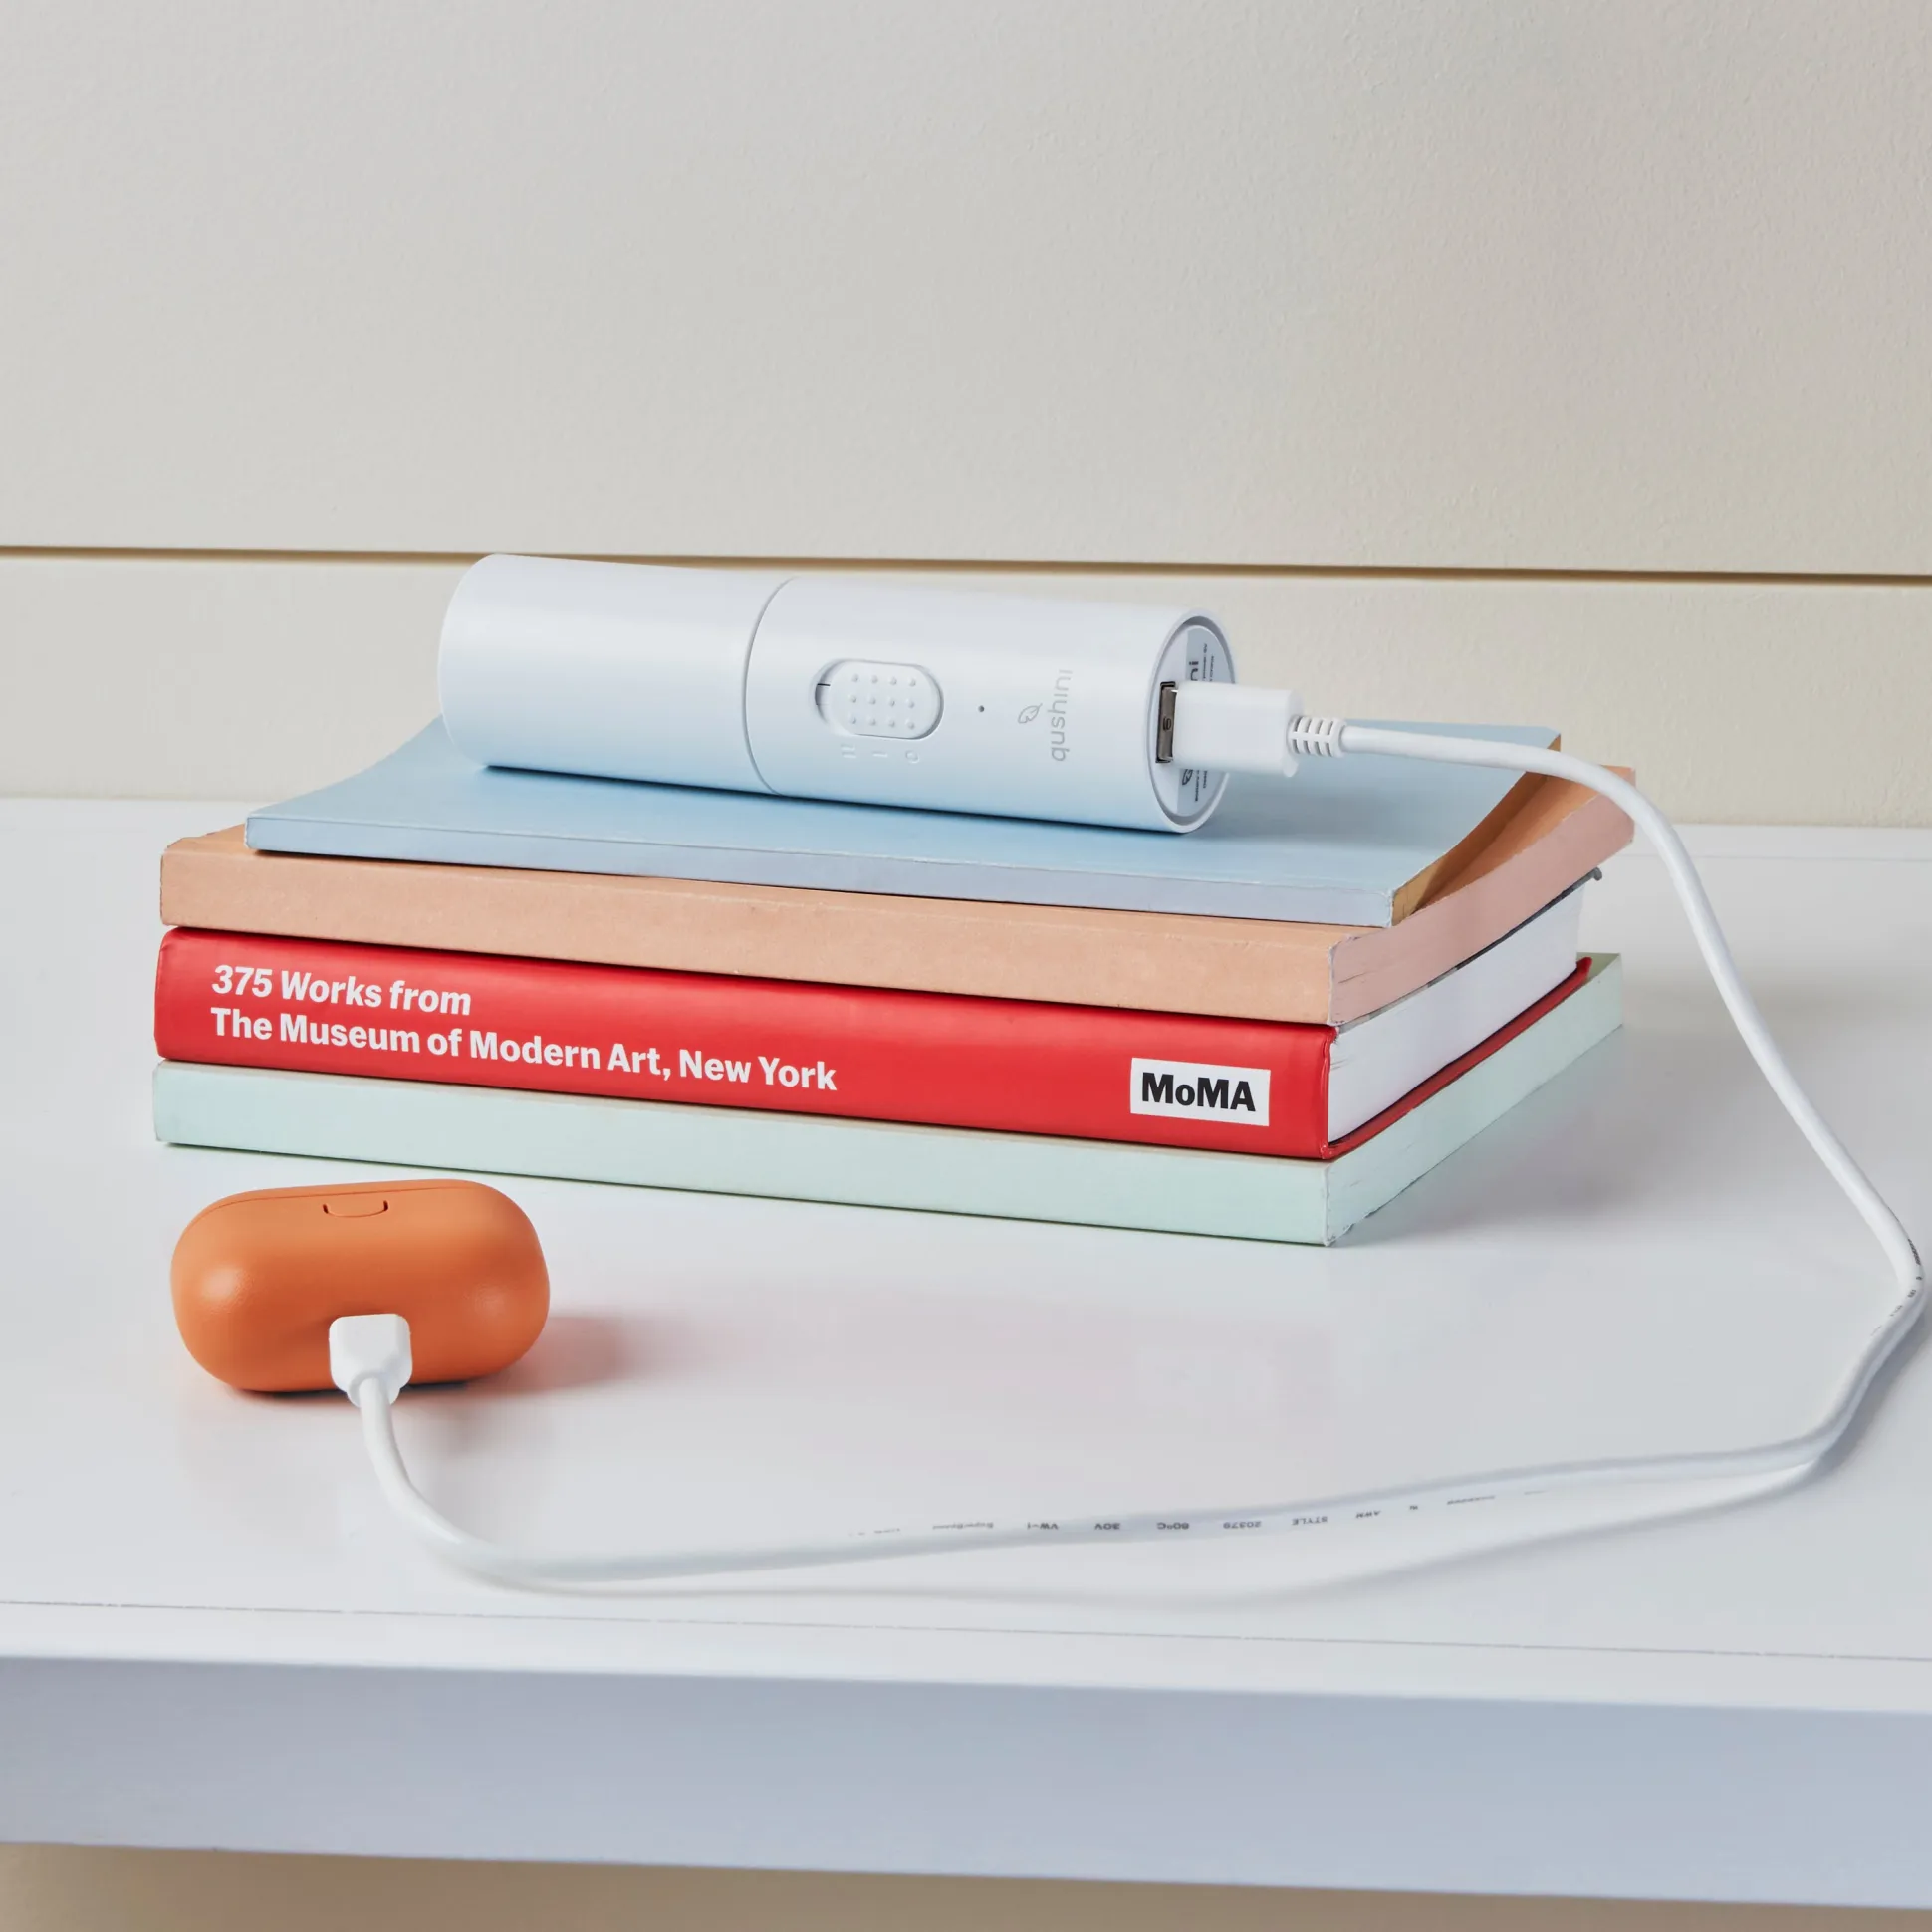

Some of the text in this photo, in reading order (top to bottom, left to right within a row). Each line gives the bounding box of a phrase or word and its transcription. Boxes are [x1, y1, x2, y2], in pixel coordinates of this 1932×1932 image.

[1047, 669, 1073, 761] qushini
[211, 963, 472, 1016] 375 Works from
[210, 1007, 838, 1091] The Museum of Modern Art, New York
[1141, 1072, 1257, 1112] MoMA
[1291, 1515, 1328, 1526] STYLE
